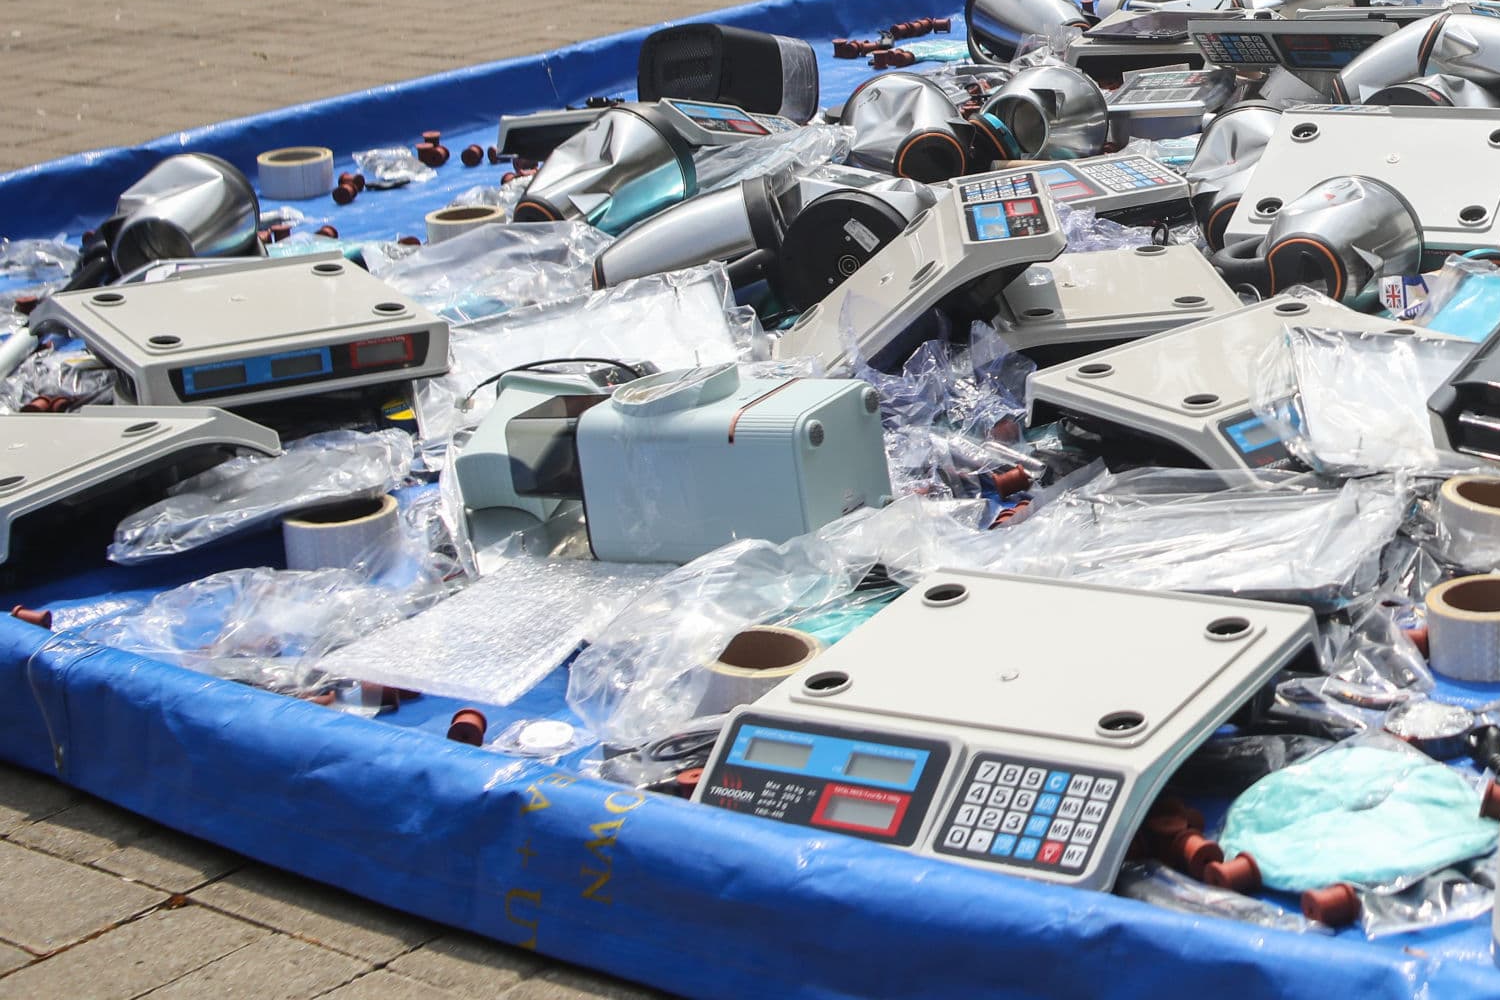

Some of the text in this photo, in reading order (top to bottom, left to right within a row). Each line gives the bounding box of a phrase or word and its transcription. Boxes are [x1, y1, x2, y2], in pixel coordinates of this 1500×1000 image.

[982, 764, 1113, 795] 7 8 9 C M1 M2
[971, 787, 984, 800] 4
[994, 790, 1008, 804] 5
[1016, 794, 1031, 808] 6
[1061, 801, 1080, 814] M3
[1084, 805, 1102, 818] M4
[964, 809, 975, 822] 1
[983, 812, 998, 825] 2
[1006, 815, 1021, 830] 3
[1051, 823, 1069, 836] M5
[1074, 827, 1092, 839] M6
[950, 829, 965, 843] 0
[1065, 848, 1083, 861] M7
